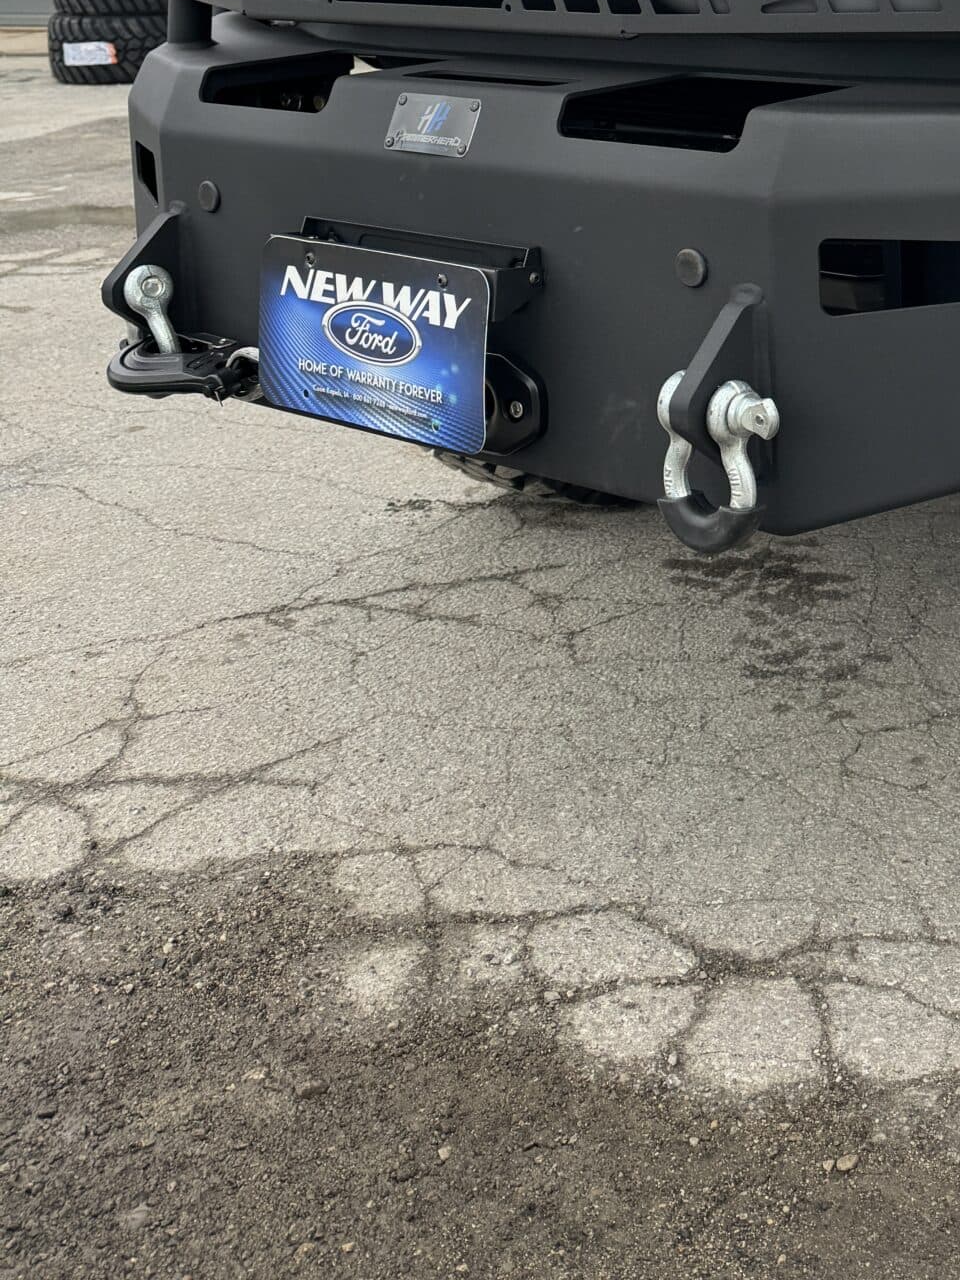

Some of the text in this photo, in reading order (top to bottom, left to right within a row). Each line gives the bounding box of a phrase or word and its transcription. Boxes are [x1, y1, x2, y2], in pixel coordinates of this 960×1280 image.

[280, 265, 472, 330] NEW WAY
[345, 312, 399, 355] Ford
[298, 358, 444, 404] HOME OF WARRANTY FOREVER
